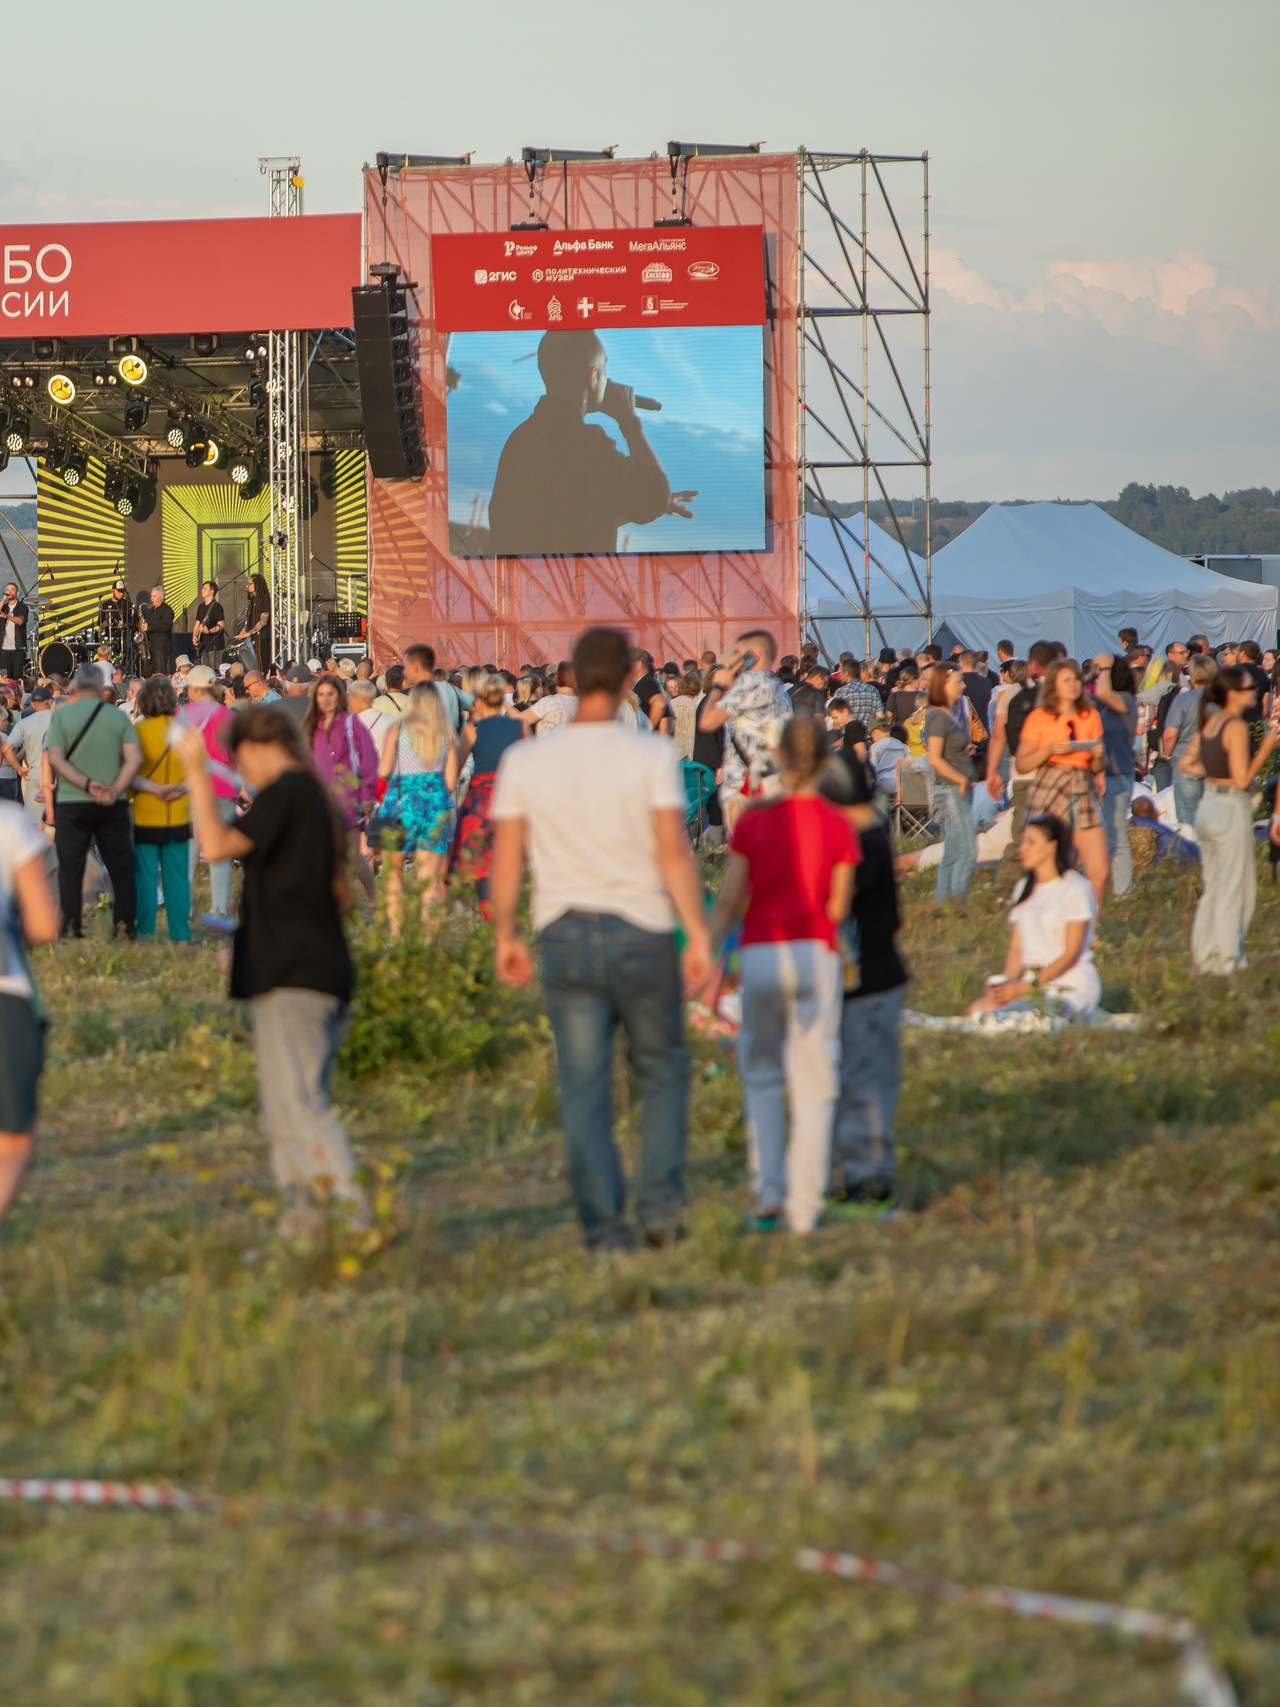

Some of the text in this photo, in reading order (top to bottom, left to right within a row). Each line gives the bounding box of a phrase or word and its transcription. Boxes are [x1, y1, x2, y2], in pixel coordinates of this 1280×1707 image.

[553, 238, 615, 255] Альфа Банк
[629, 240, 687, 252] МегаАльянс
[488, 270, 518, 282] 2ГИС
